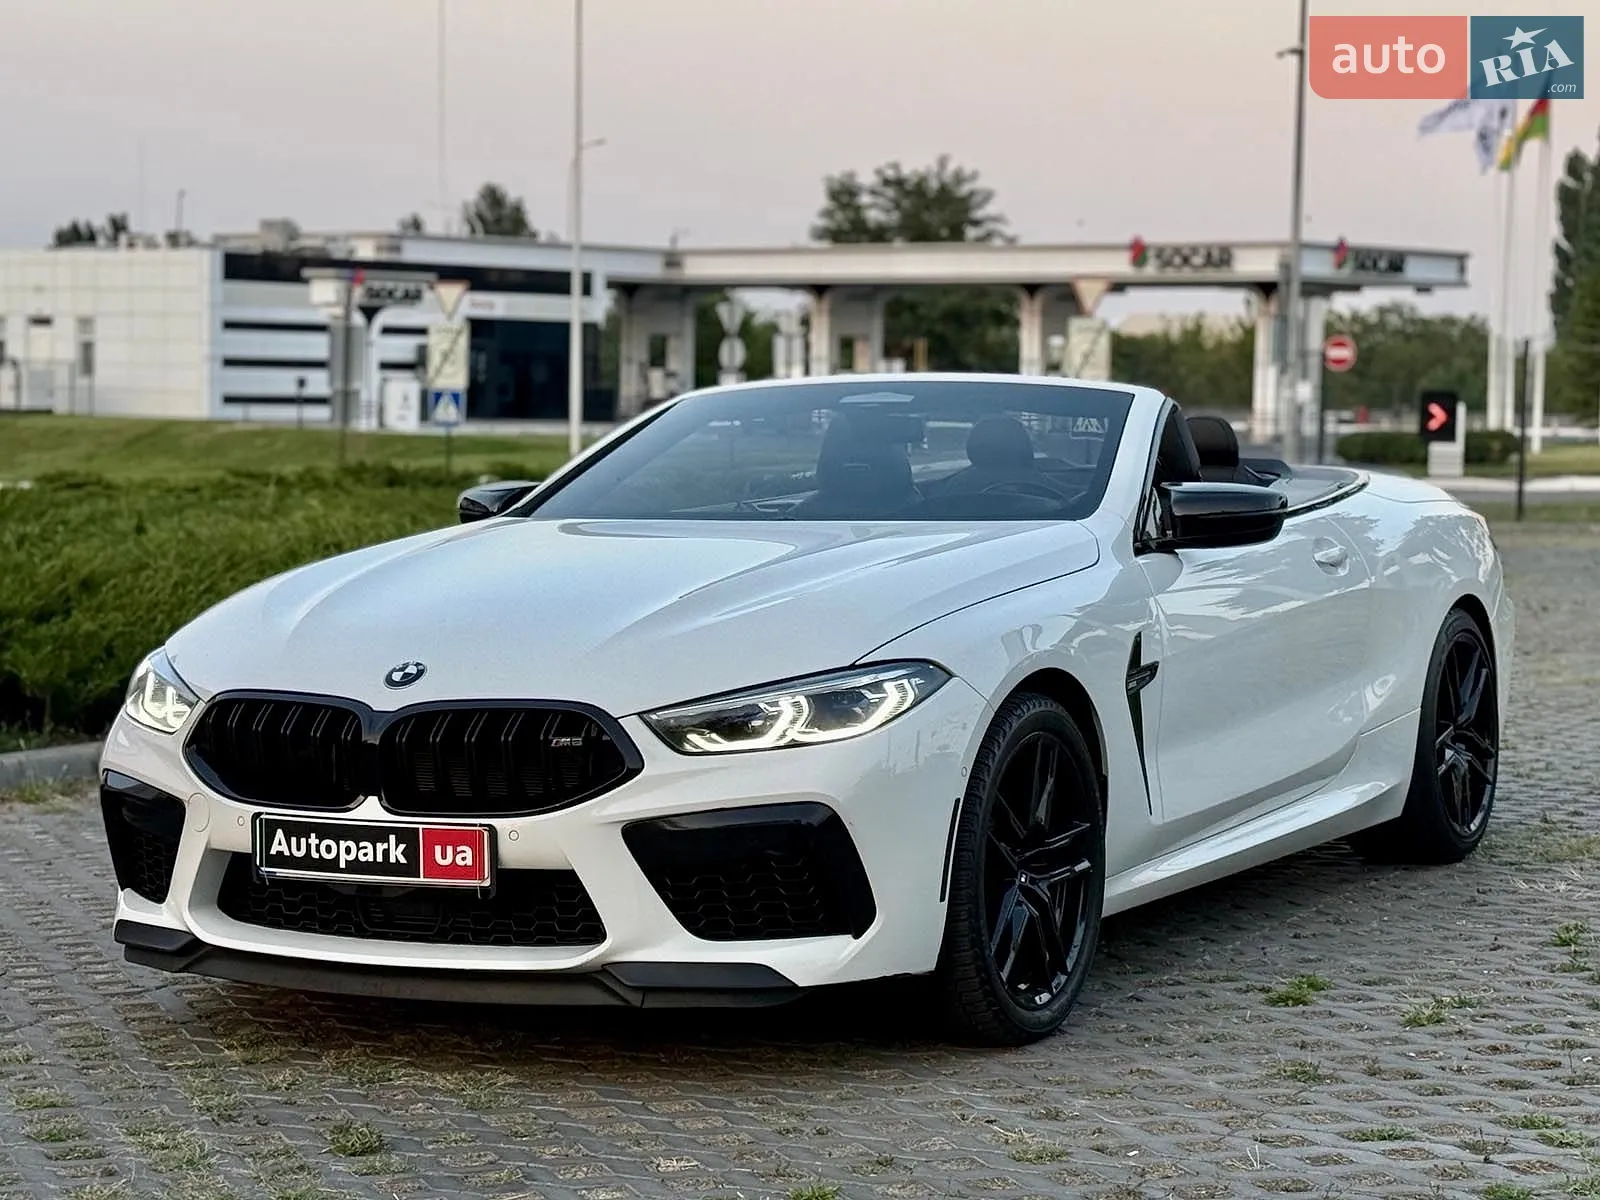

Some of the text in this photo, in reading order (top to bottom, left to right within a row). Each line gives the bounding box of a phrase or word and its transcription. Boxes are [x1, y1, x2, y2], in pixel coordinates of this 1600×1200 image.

[1154, 247, 1232, 269] SOCAR
[269, 828, 474, 868] Autopark ua
